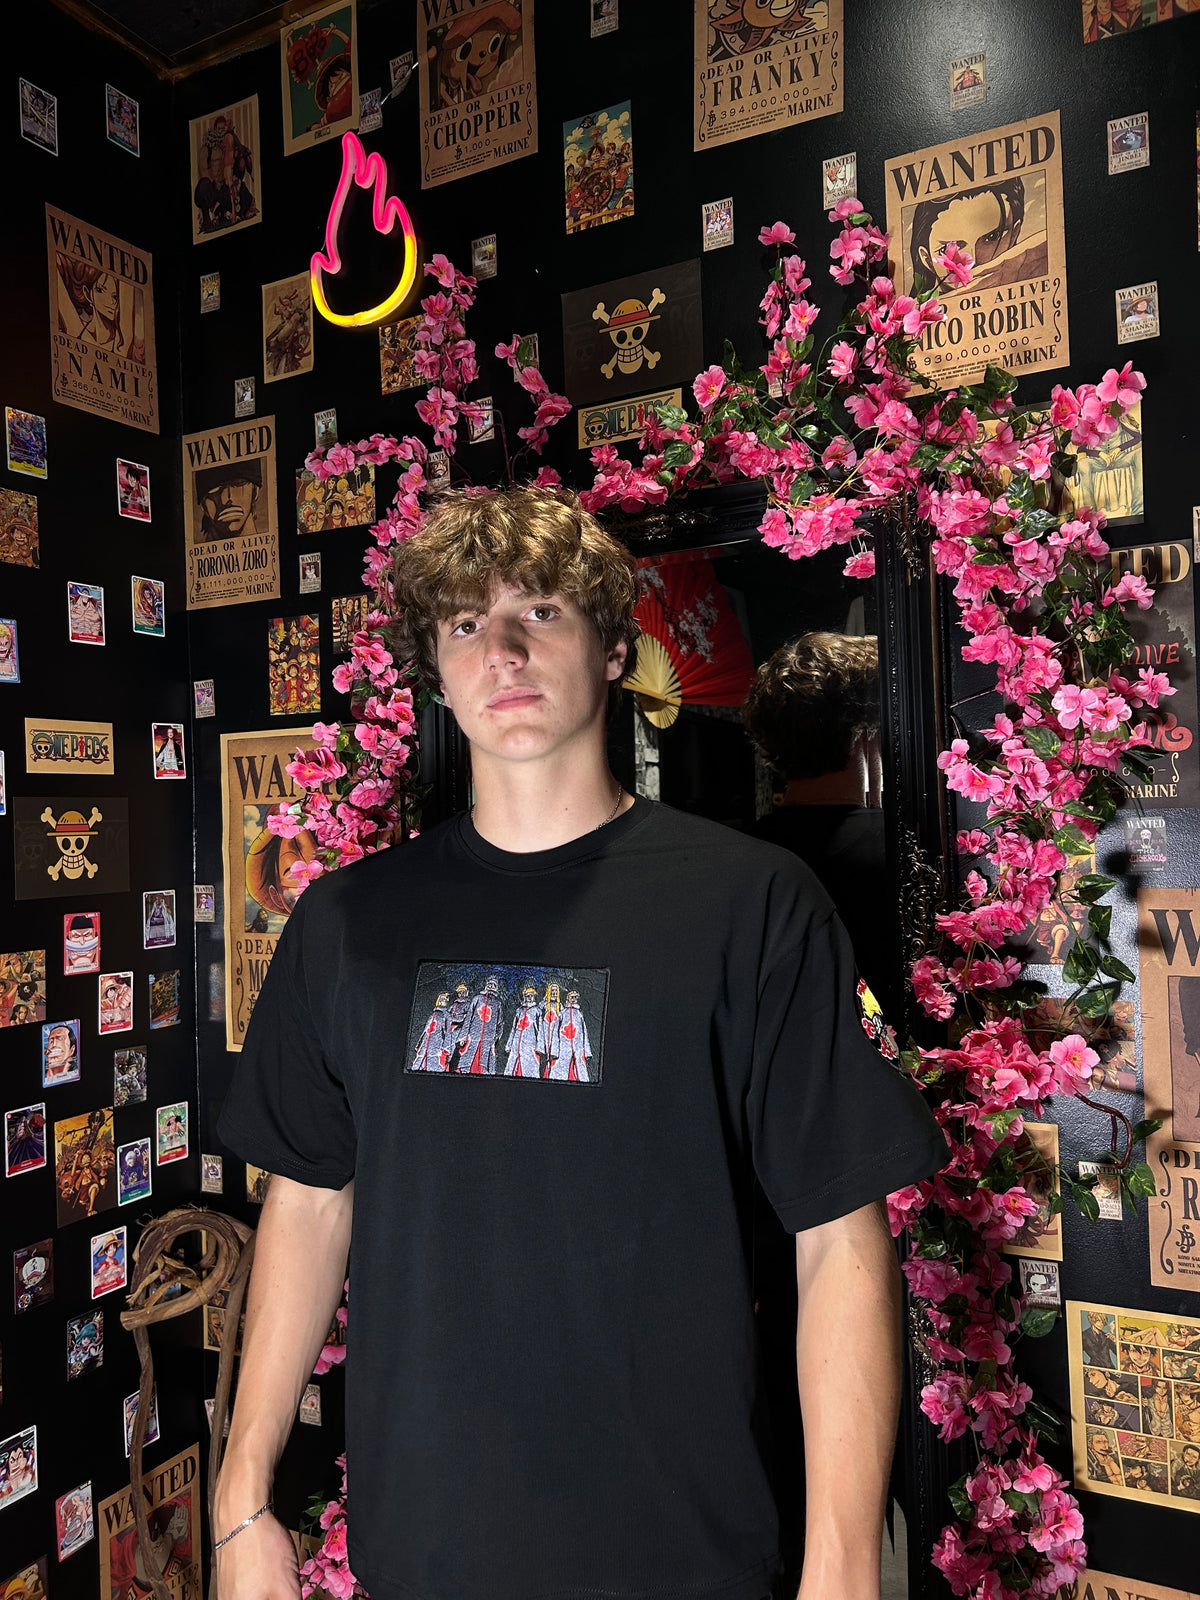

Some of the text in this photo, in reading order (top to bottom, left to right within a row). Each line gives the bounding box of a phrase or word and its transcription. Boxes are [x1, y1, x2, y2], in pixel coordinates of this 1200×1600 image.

[707, 31, 830, 80] DEAD OR ALIVE
[951, 53, 985, 70] WANTED
[711, 50, 824, 108] FRANKY
[429, 83, 526, 128] DEAD OR ALIVE
[786, 92, 834, 119] MARINE
[433, 100, 522, 150] CHOPPER
[1109, 115, 1148, 132] WANTED
[493, 136, 530, 159] MARINE
[825, 154, 856, 170] WANTED
[890, 125, 1056, 202] WANTED
[704, 200, 733, 213] WANTED
[49, 214, 148, 286] WANTED
[959, 295, 982, 312] OR
[994, 278, 1051, 304] ALIVE
[1118, 284, 1157, 300] WANTED
[972, 297, 1046, 342] ROBIN
[1125, 323, 1154, 333] SHANKS
[59, 335, 149, 379] DEAD OR ALIVE
[1001, 344, 1058, 369] MARINE
[67, 352, 142, 398] NAMI
[120, 406, 152, 426] MARINE
[185, 424, 272, 468] WANTED
[194, 534, 271, 557] DEAD OR ALIVE
[197, 547, 268, 579] RORONOA ZORO
[245, 581, 275, 596] MARINE
[1128, 642, 1181, 666] LIVE
[1123, 783, 1178, 799] MARINE
[1126, 818, 1166, 830] WANTED
[244, 938, 280, 955] DEA
[1021, 1261, 1058, 1275] WANTED
